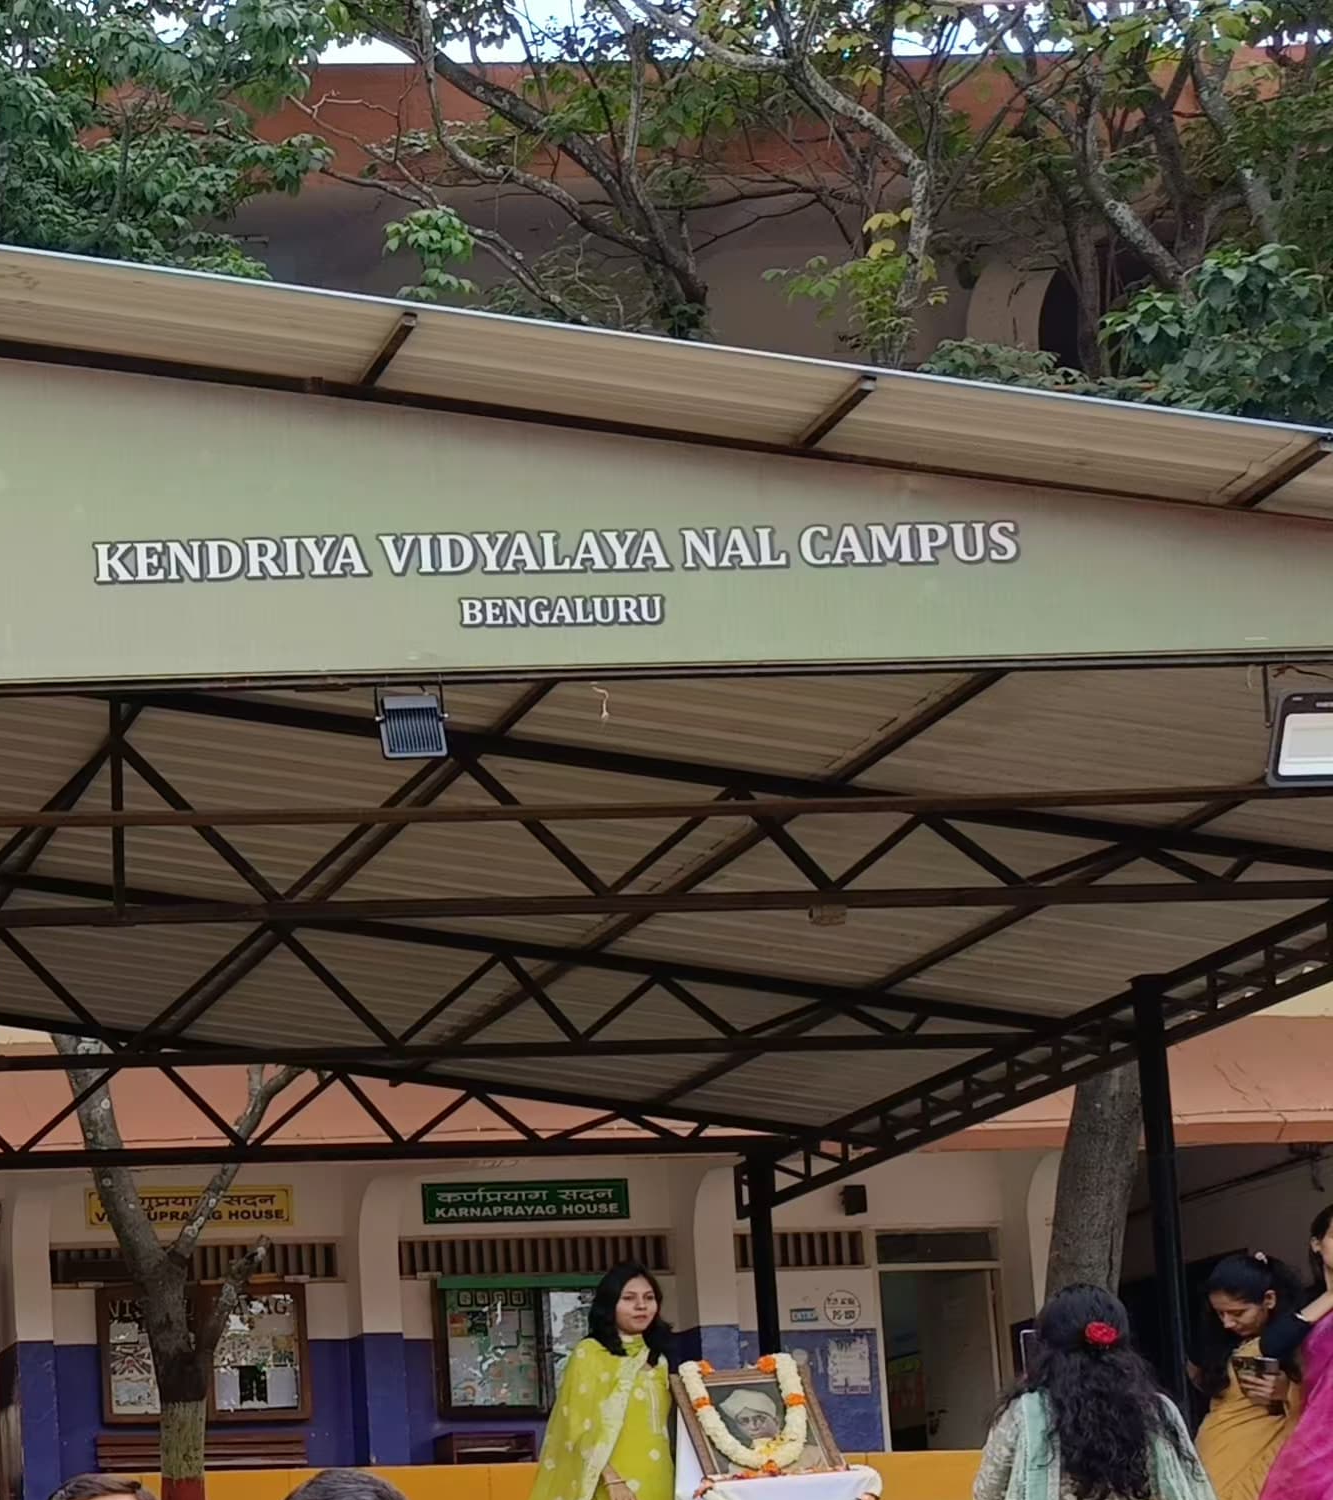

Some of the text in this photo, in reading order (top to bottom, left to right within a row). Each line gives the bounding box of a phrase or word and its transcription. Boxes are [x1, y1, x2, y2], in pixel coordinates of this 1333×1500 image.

[92, 519, 1021, 585] KENDRIYA VIDYALAYA NAL CAMPUS
[459, 595, 664, 628] BENGALURU
[224, 1194, 277, 1207] सदन
[436, 1187, 614, 1203] कर्णप्रयाग सदन
[228, 1209, 284, 1220] HOUSE
[435, 1202, 620, 1218] KARNAPRAYAG HOUSE
